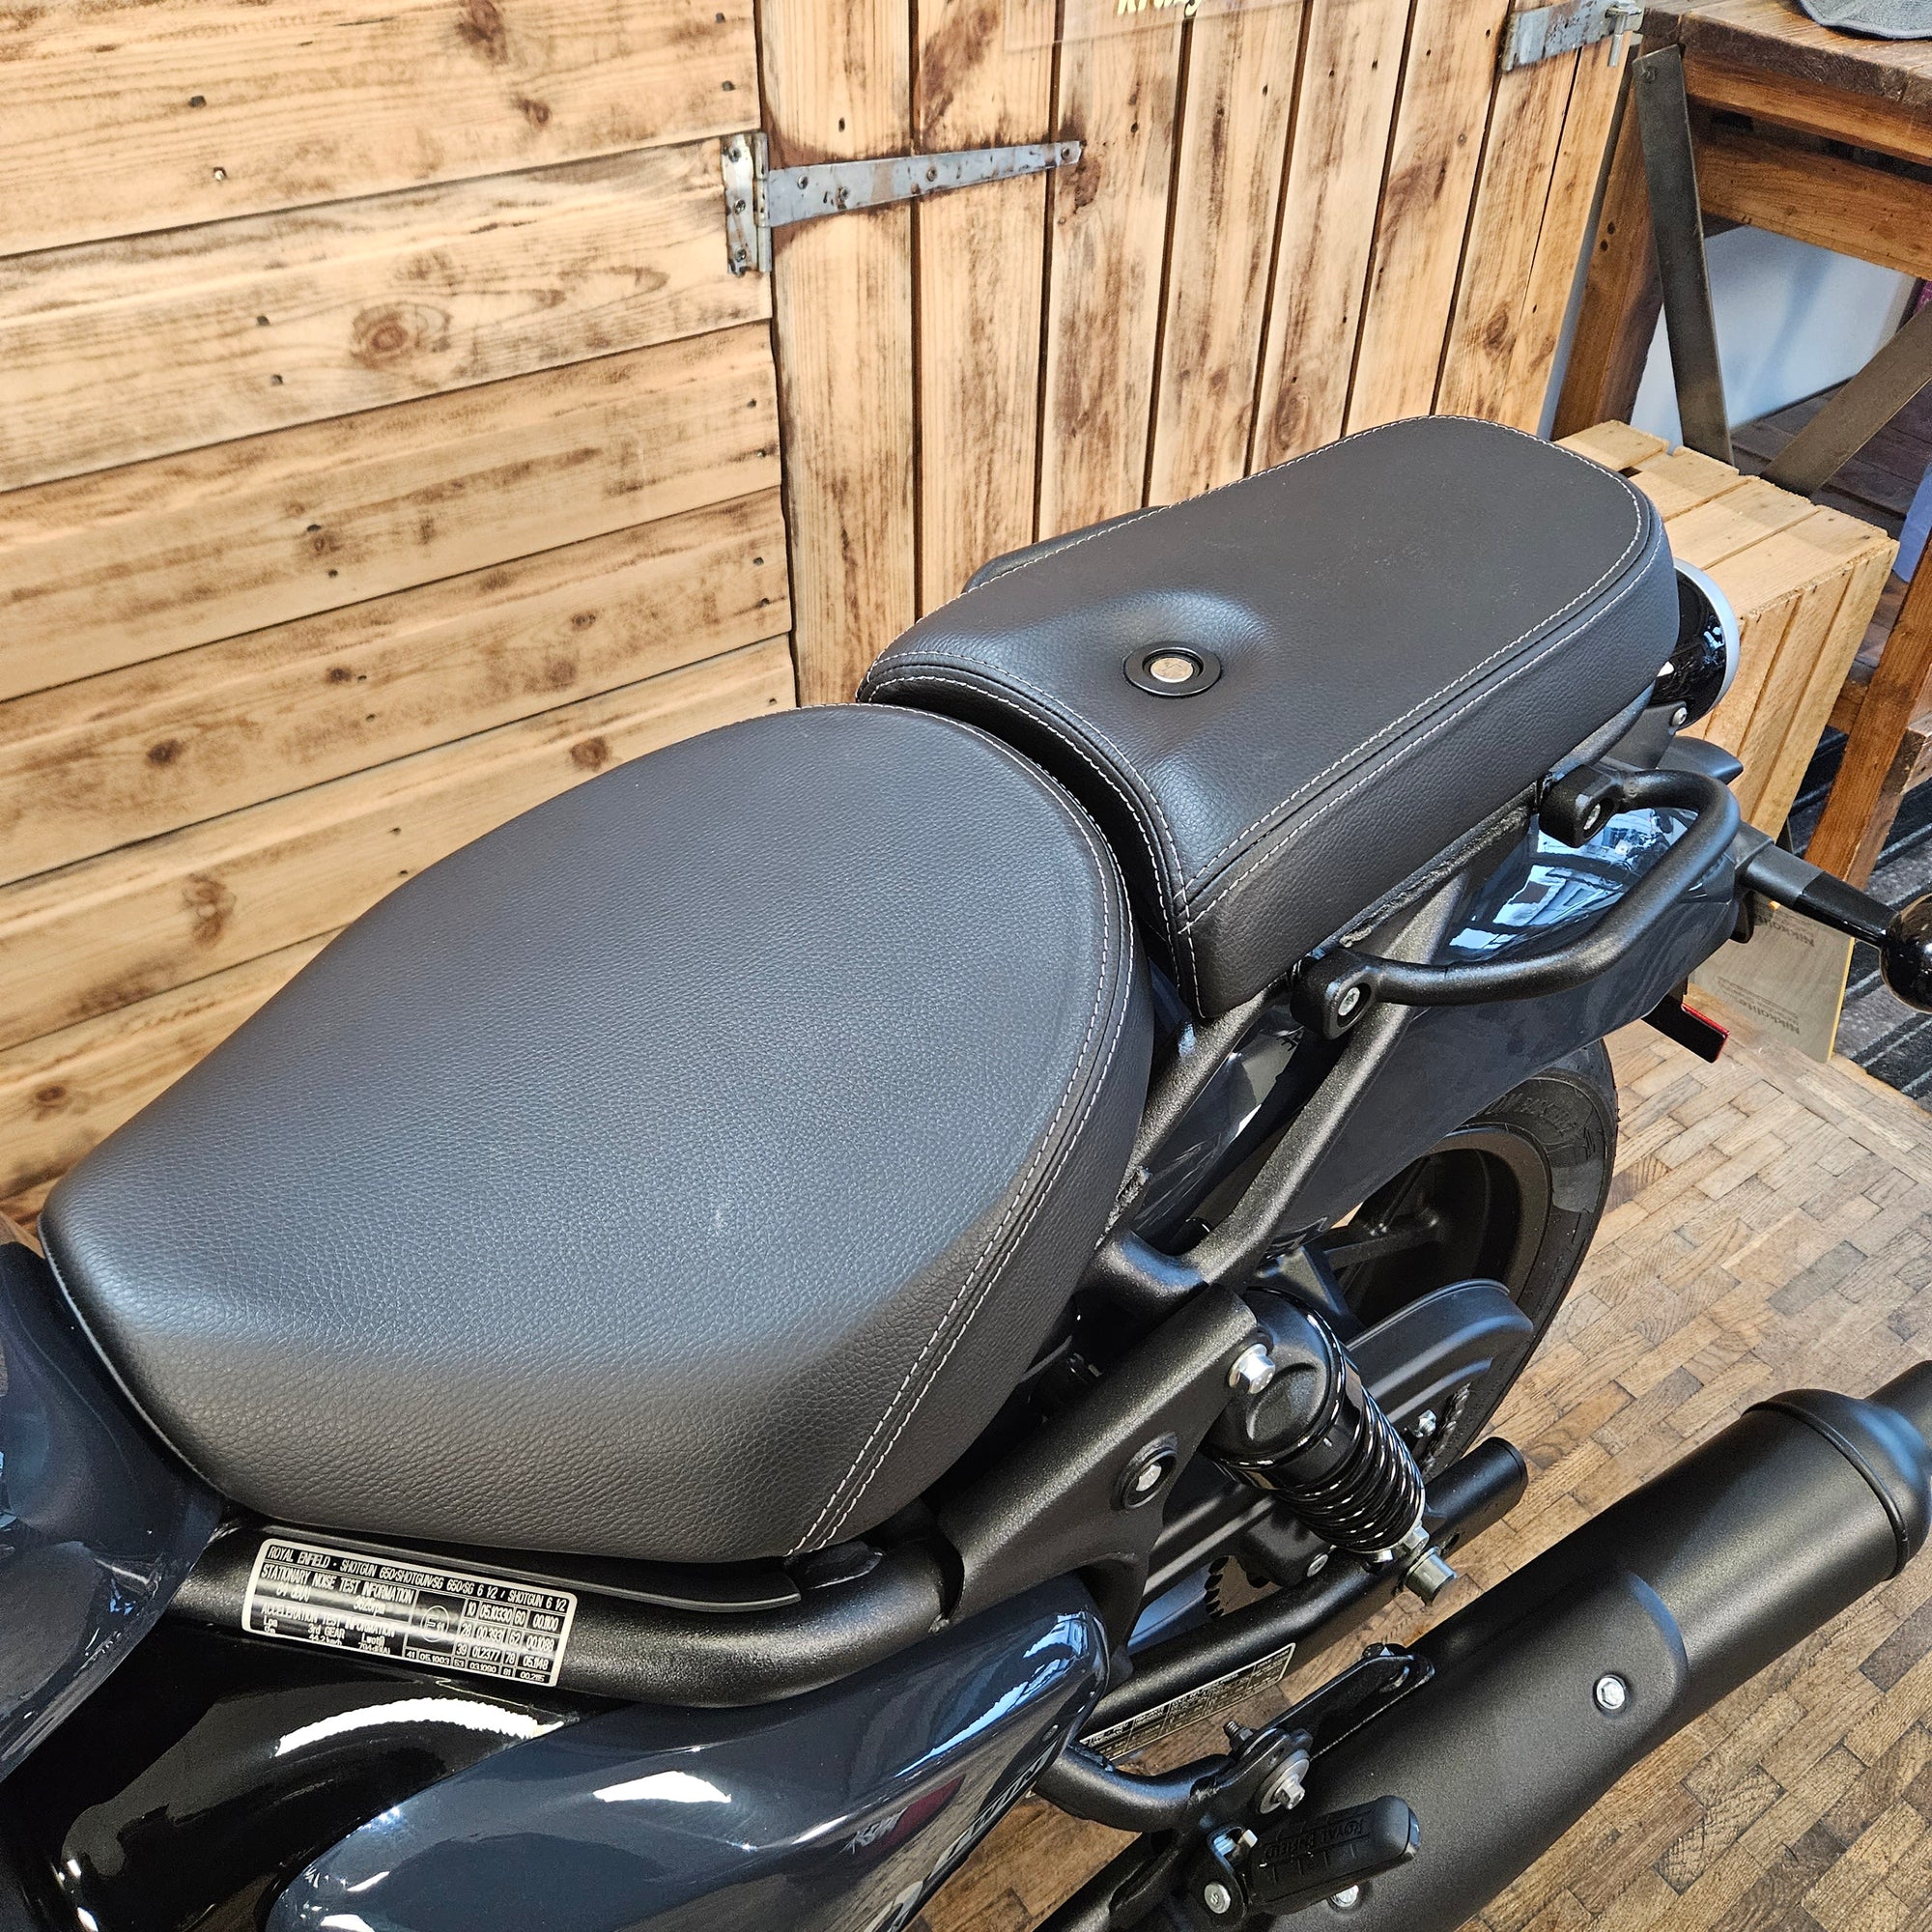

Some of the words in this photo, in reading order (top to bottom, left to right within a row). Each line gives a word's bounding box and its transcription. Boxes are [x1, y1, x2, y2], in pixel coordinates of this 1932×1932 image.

[260, 1563, 312, 1585] STATIONARY
[312, 1570, 337, 1591] NOISE
[338, 1575, 362, 1595] TEST
[361, 1577, 415, 1605] INFORMATION
[267, 1546, 295, 1563] ROYAL
[297, 1550, 331, 1569] ENFIELD
[339, 1558, 378, 1577] SHOTGUN
[476, 1583, 484, 1597] 6
[507, 1589, 545, 1607] SHOTGUN
[545, 1596, 554, 1609] 6
[261, 1602, 319, 1624] ACCELERATION
[322, 1610, 342, 1627] TEST
[344, 1614, 396, 1638] INFORMATION
[466, 1601, 478, 1617] 10
[514, 1609, 526, 1626] 60
[324, 1627, 346, 1640] GEAR
[461, 1622, 473, 1638] 28
[508, 1631, 522, 1647] 62
[455, 1642, 469, 1657] 39
[504, 1651, 517, 1664] 78
